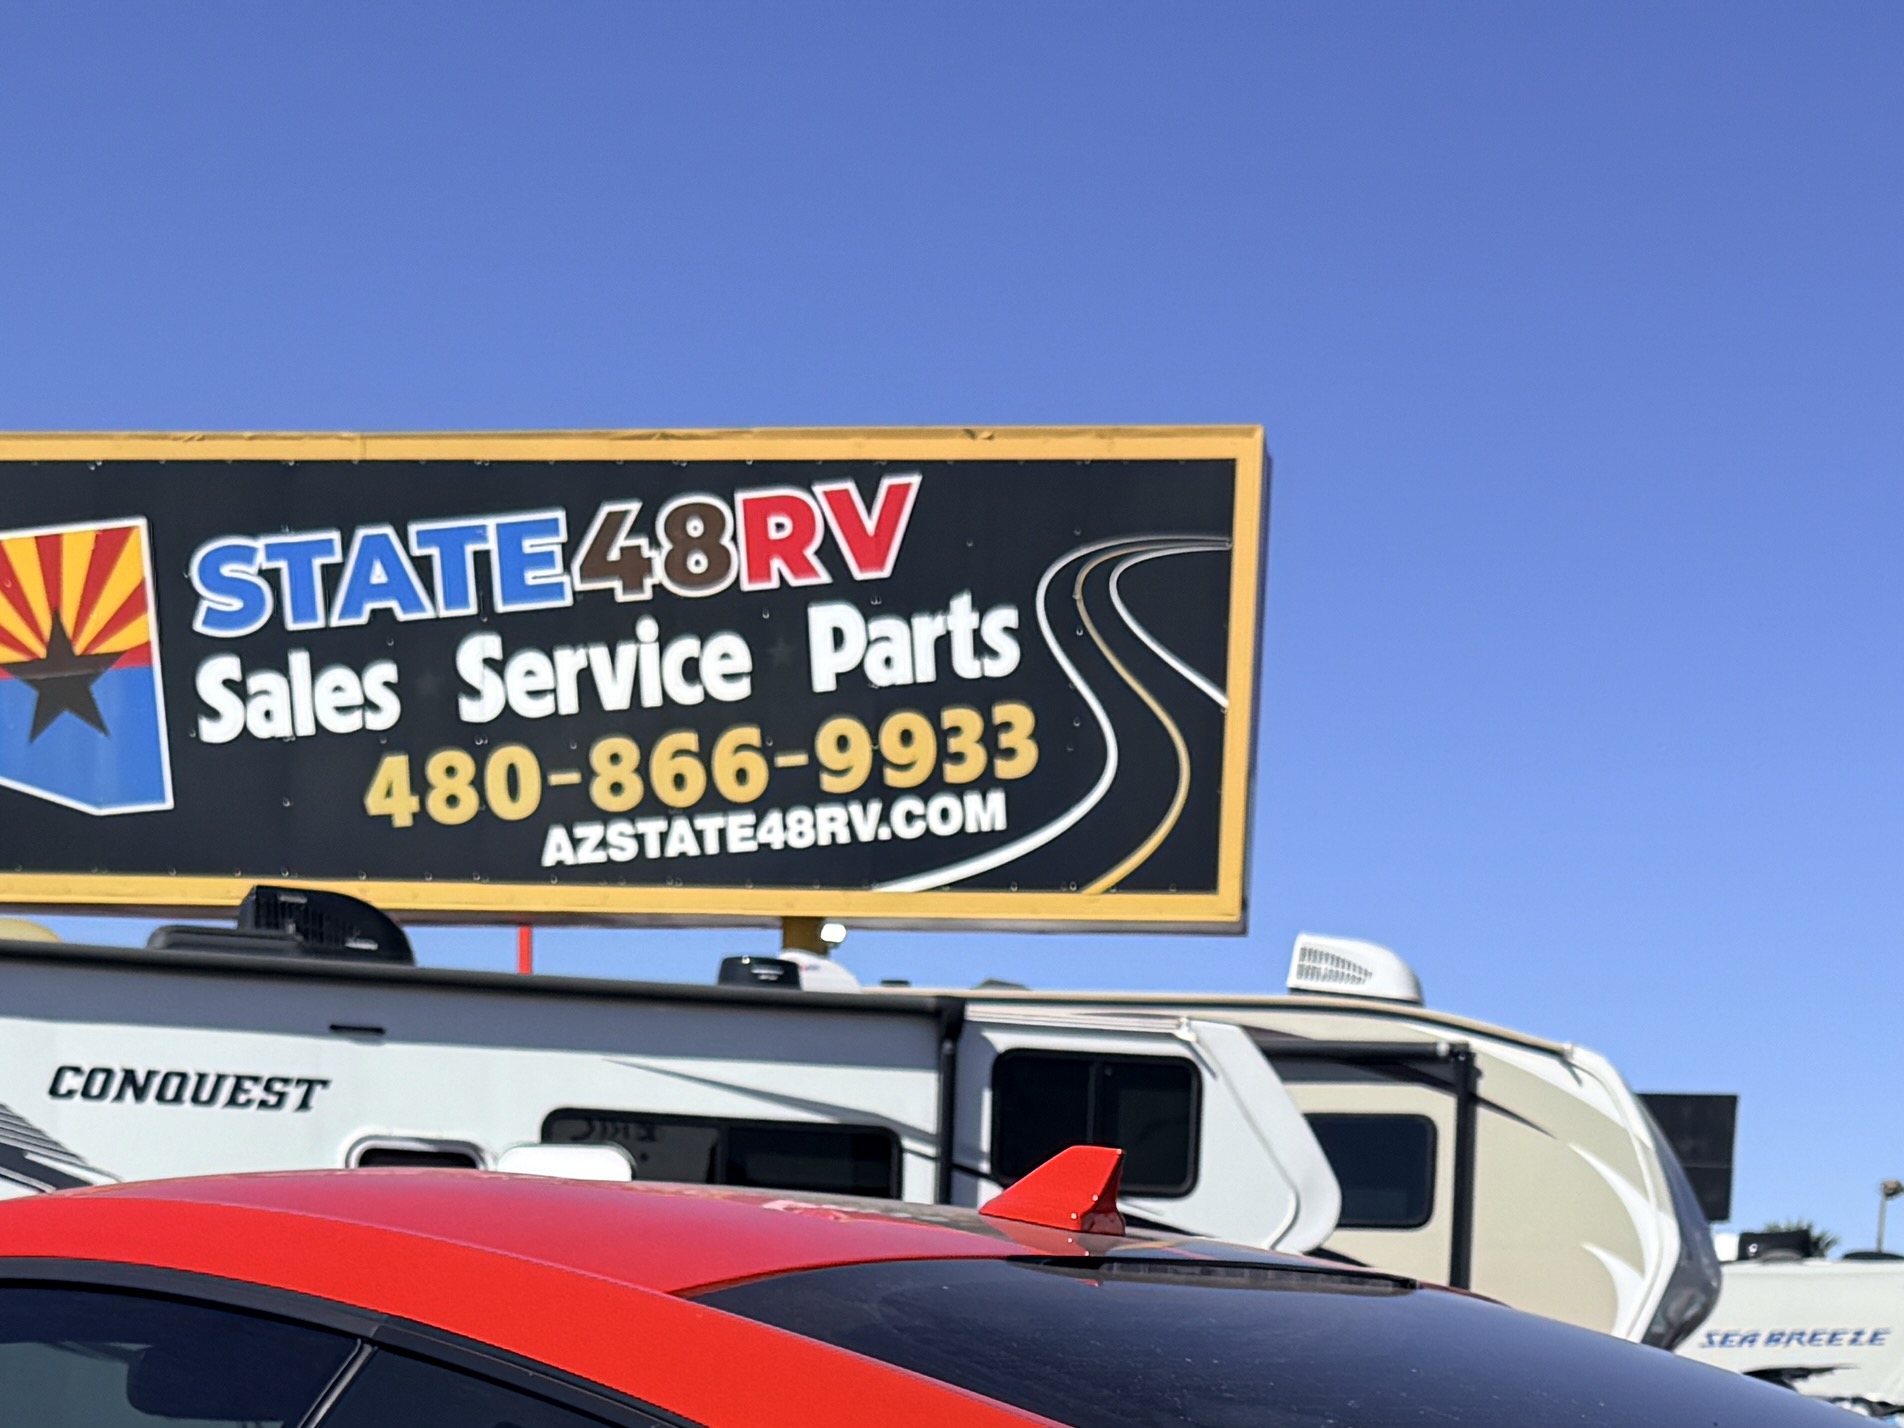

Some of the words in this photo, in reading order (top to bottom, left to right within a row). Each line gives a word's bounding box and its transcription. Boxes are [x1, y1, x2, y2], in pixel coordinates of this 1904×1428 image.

[190, 472, 924, 638] STATE48RV
[196, 647, 403, 744] Sales
[456, 613, 753, 723] Service
[807, 589, 1021, 693] Parts
[364, 701, 1040, 828] 480-866-9933
[542, 789, 1007, 867] AZSTATE48RV.COM
[48, 1065, 332, 1113] CONQUEST
[1699, 1328, 1762, 1349] SEA
[1763, 1328, 1891, 1349] BREEZE
